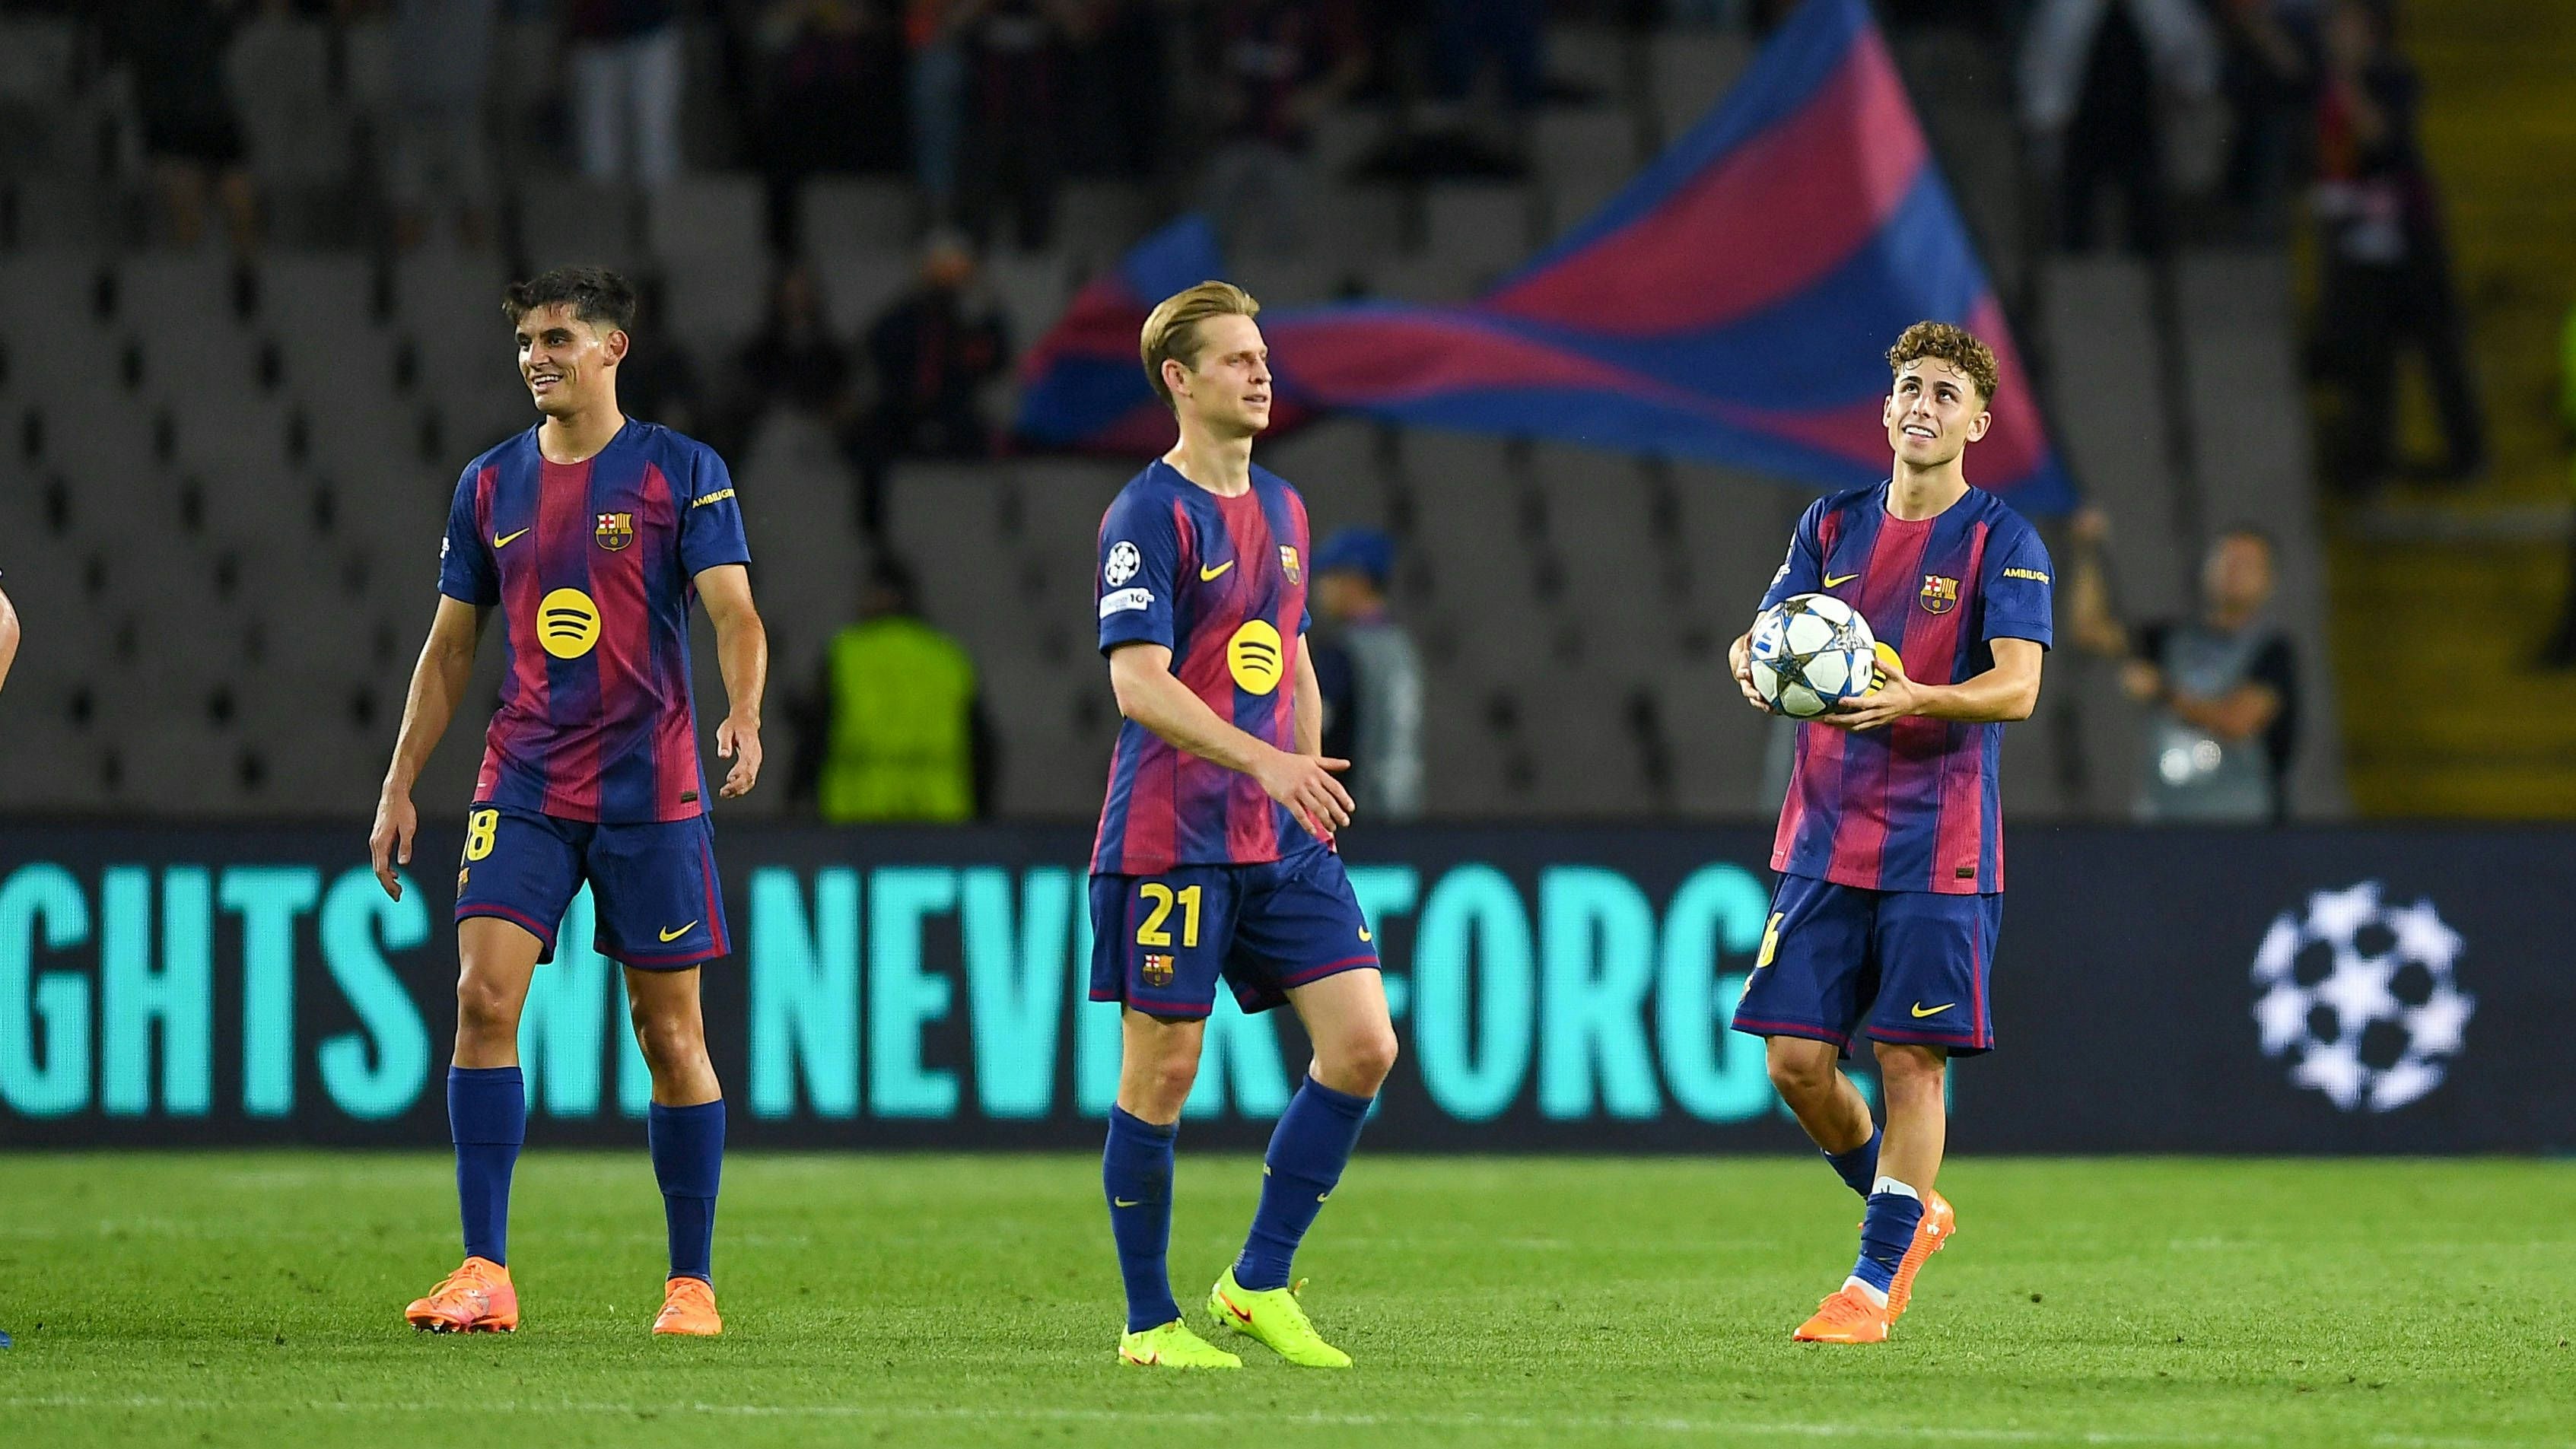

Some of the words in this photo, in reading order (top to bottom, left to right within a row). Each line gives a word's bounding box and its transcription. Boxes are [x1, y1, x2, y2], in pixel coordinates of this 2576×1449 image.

[460, 809, 500, 868] 8
[1136, 882, 1201, 947] 21
[1755, 911, 1785, 968] 6
